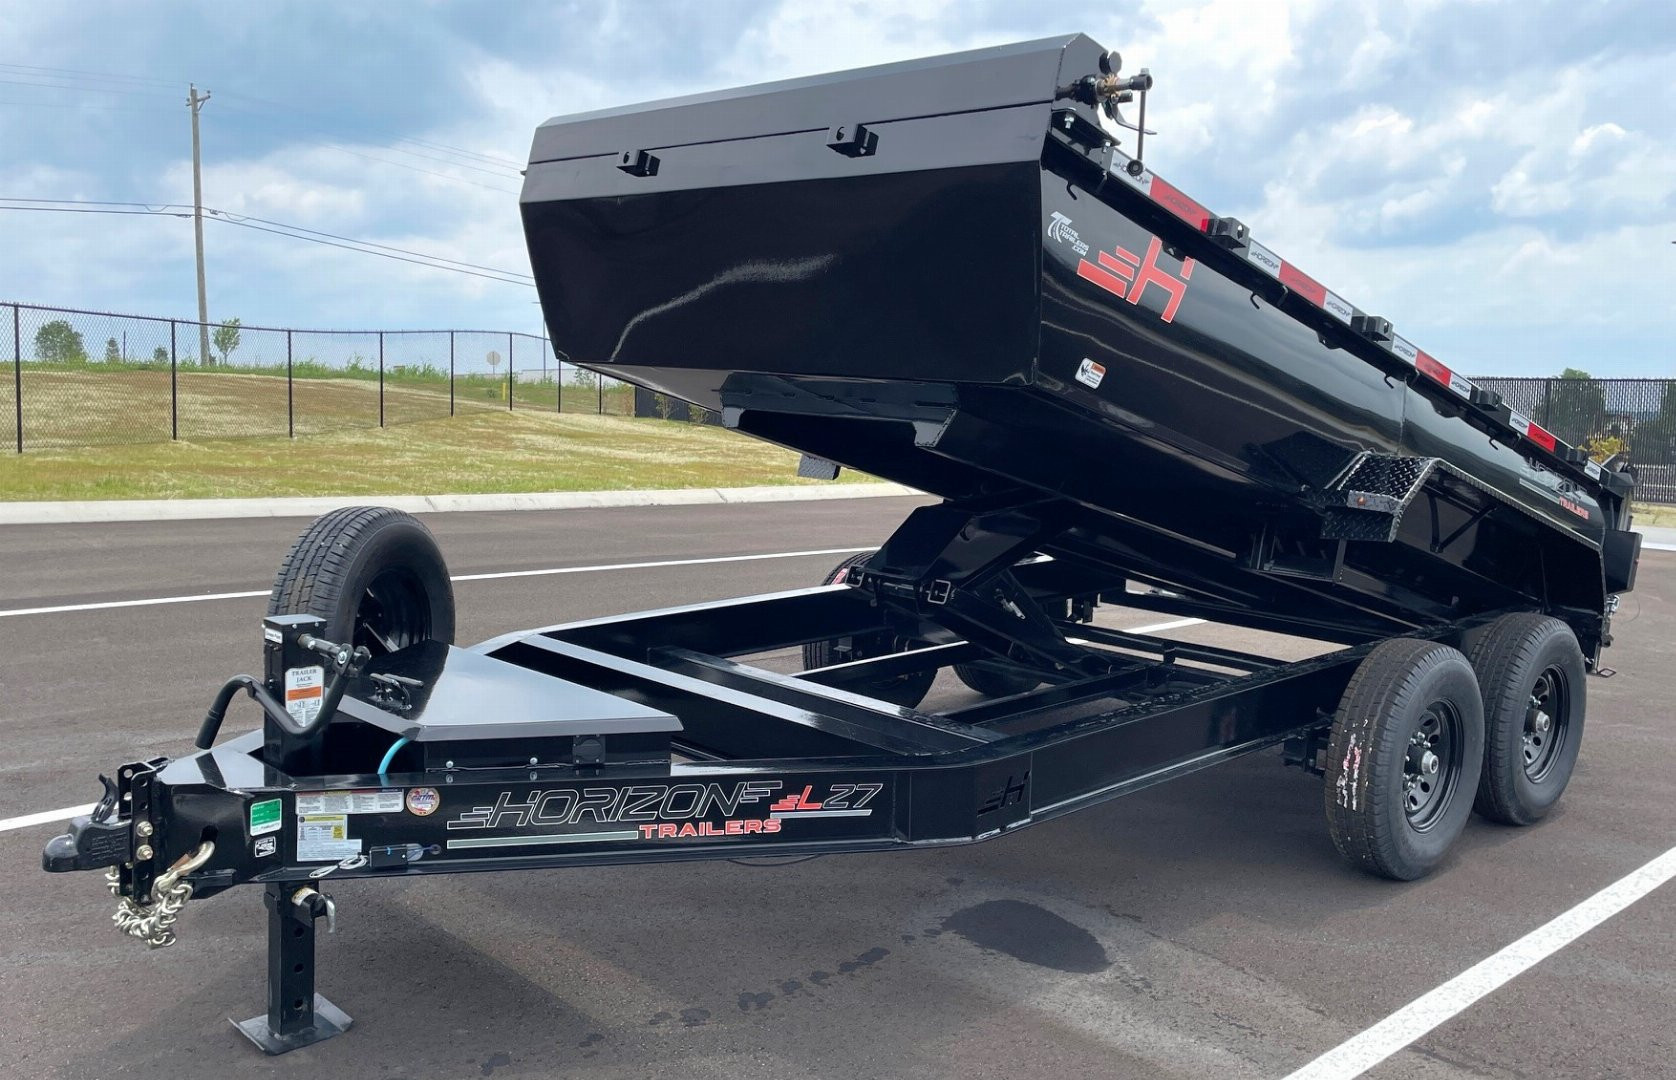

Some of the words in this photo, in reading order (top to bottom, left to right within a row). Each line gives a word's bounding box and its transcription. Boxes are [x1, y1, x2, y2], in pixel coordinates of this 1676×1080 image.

[1059, 224, 1080, 240] TOTAL
[1059, 229, 1090, 251] TRAILERS
[292, 668, 317, 676] TRAILER
[486, 781, 747, 828] HORIZON
[639, 818, 782, 839] TRAILERS
